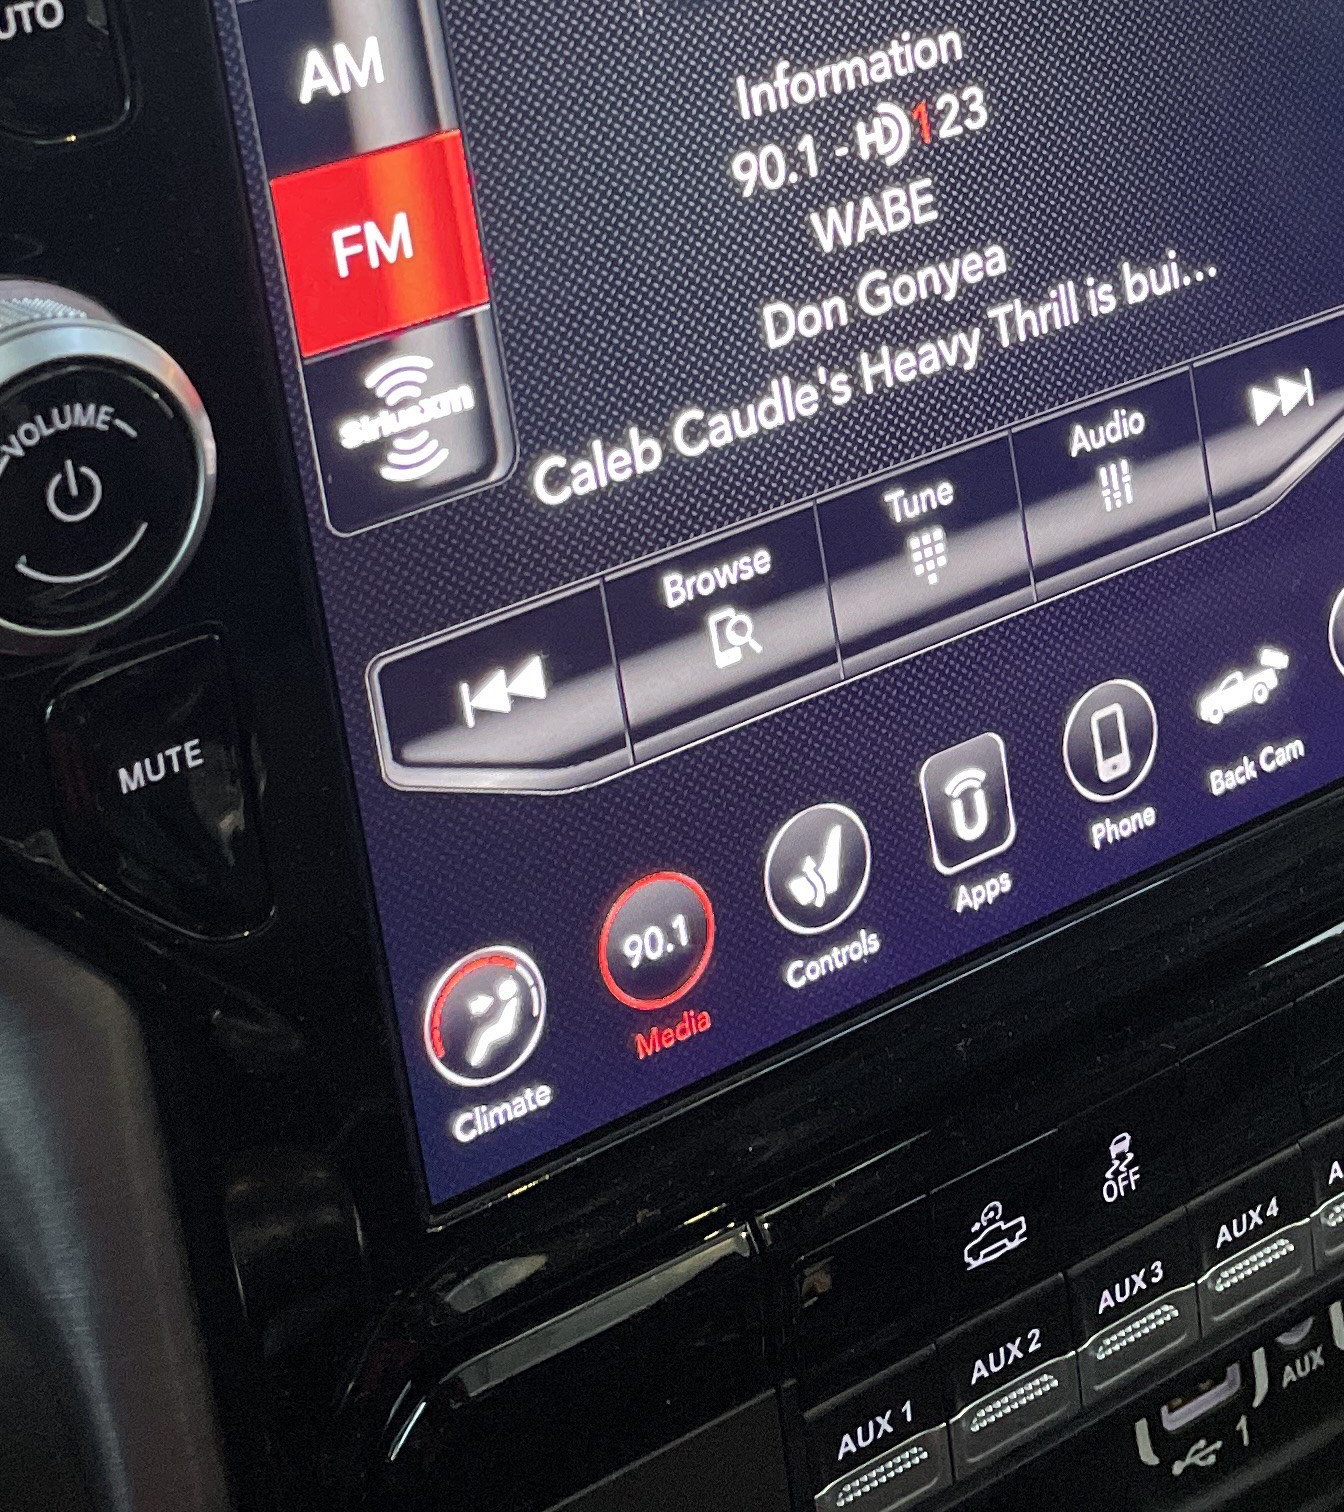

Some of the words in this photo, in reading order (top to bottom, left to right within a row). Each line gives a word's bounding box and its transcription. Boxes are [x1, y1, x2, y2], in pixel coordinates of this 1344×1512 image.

[297, 35, 385, 105] AM
[736, 28, 963, 120] Information
[731, 133, 819, 198] 90.1
[811, 178, 939, 253] WABE
[331, 212, 414, 279] FM
[763, 295, 847, 350] Don
[858, 243, 1008, 317] Gonyea
[533, 428, 662, 506] Caleb
[673, 368, 851, 457] Caudle's
[861, 325, 980, 395] Heavy
[987, 281, 1079, 349] Thrill
[1086, 276, 1114, 318] is
[0, 402, 115, 460] VOLUME
[1070, 408, 1145, 458] Audio
[883, 478, 954, 523] Tune
[663, 548, 771, 608] Browse
[117, 738, 205, 794] MUTE
[1209, 756, 1258, 796] Back
[1260, 739, 1305, 774] Cam
[1092, 805, 1157, 850] Phone
[955, 870, 1012, 912] Apps
[623, 914, 690, 968] 90.1
[785, 929, 880, 989] Controls
[636, 1009, 711, 1060] Media
[452, 1084, 552, 1143] Climate
[1102, 1167, 1140, 1203] OFF
[1215, 1207, 1264, 1249] AUX
[1265, 1197, 1279, 1219] 4
[1098, 1272, 1148, 1314] AUX
[1150, 1261, 1164, 1284] 3
[970, 1343, 1021, 1385] AUX
[1026, 1328, 1042, 1352] 2
[1281, 1344, 1325, 1388] AUX
[837, 1412, 892, 1460] AUX
[903, 1401, 913, 1422] 1
[1234, 1415, 1250, 1444] 1
